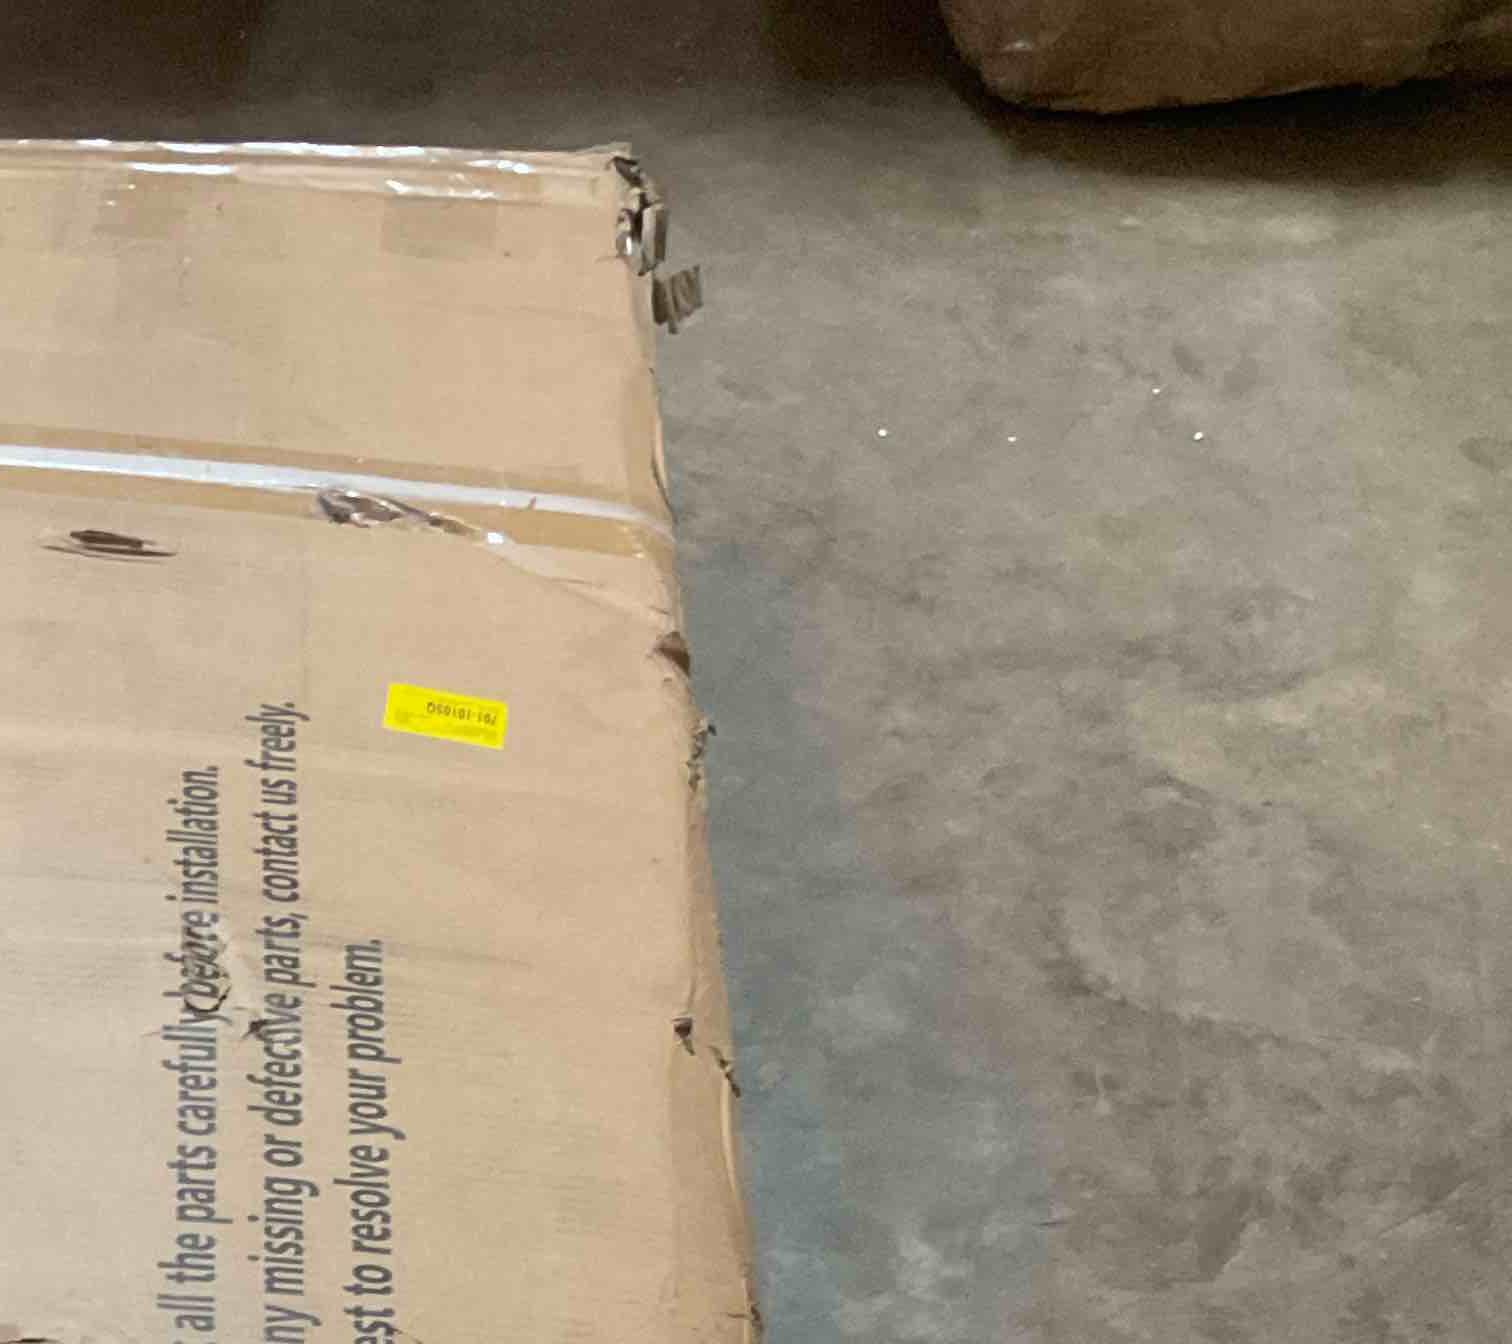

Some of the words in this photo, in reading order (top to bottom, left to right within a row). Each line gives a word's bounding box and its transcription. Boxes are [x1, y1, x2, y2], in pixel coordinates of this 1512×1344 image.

[243, 702, 310, 772] freely.
[262, 779, 297, 805] us
[165, 766, 219, 905] installation.
[252, 812, 299, 903] contact
[254, 912, 317, 987] parts,
[328, 939, 402, 1064] problem.
[162, 1008, 232, 1136] carefully
[246, 993, 303, 1127] defective
[346, 1069, 405, 1141] your
[166, 1146, 233, 1226] parts
[262, 1134, 303, 1168] or
[245, 1177, 320, 1297] missing
[331, 1145, 391, 1256] resolve
[157, 1234, 216, 1283] the
[342, 1264, 393, 1297] to
[157, 1295, 216, 1332] all
